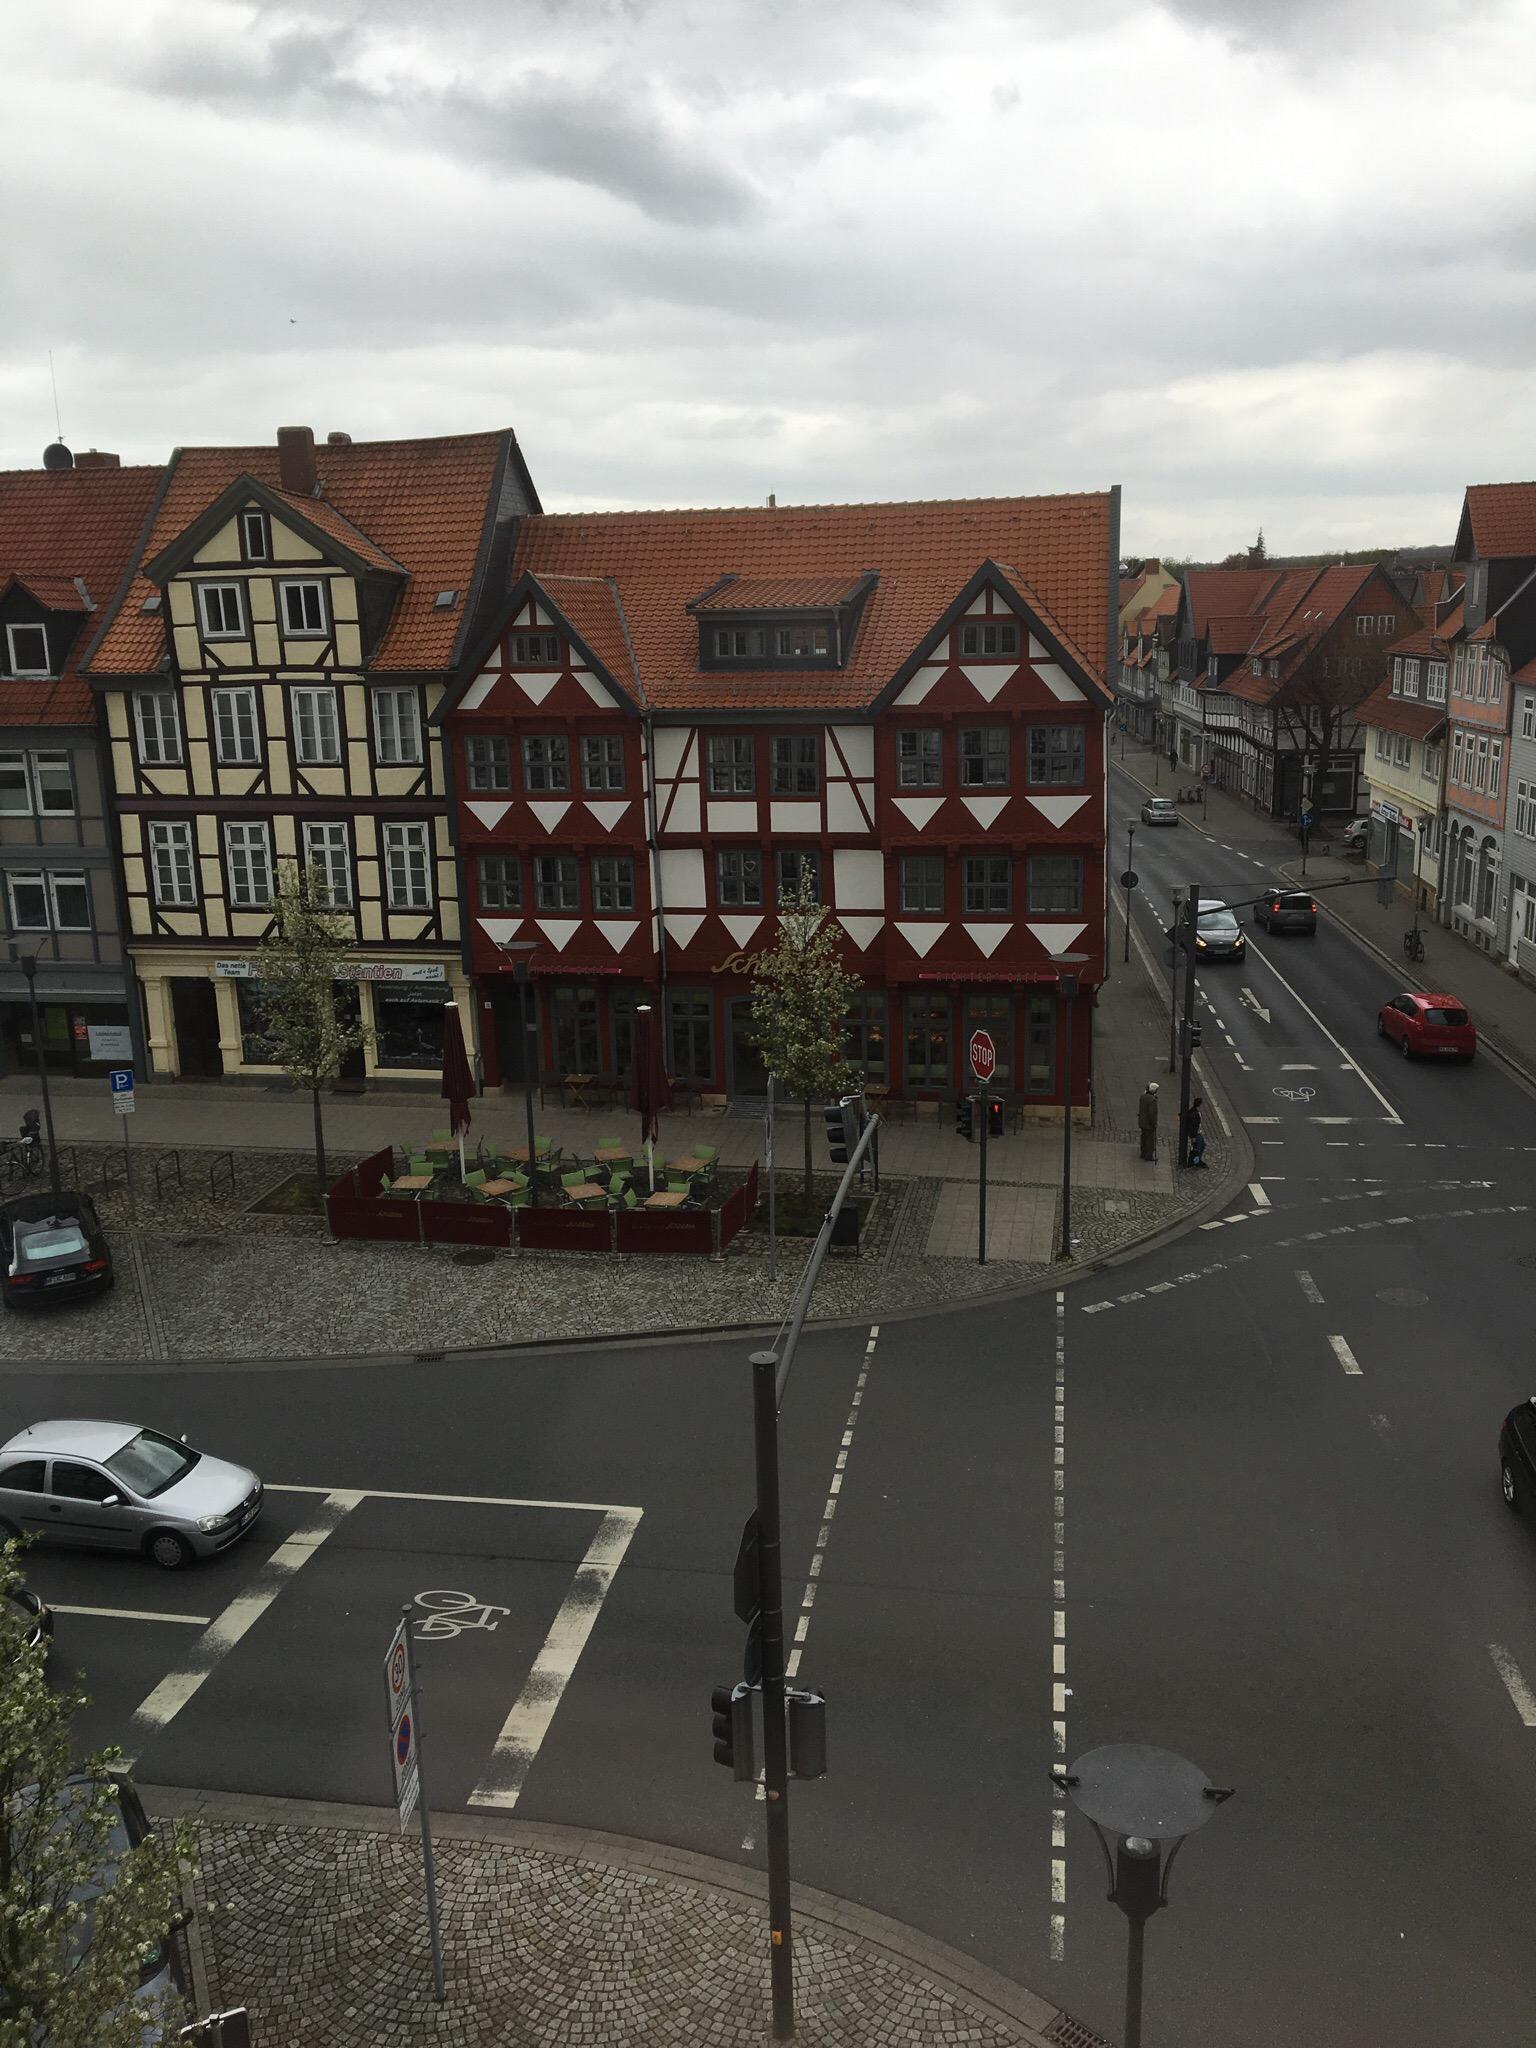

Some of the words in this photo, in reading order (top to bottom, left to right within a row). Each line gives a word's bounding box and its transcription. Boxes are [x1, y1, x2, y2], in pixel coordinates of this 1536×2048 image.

[337, 964, 403, 979] Stantien
[973, 1043, 992, 1067] STOP
[115, 1074, 128, 1089] P
[395, 1654, 403, 1683] 30
